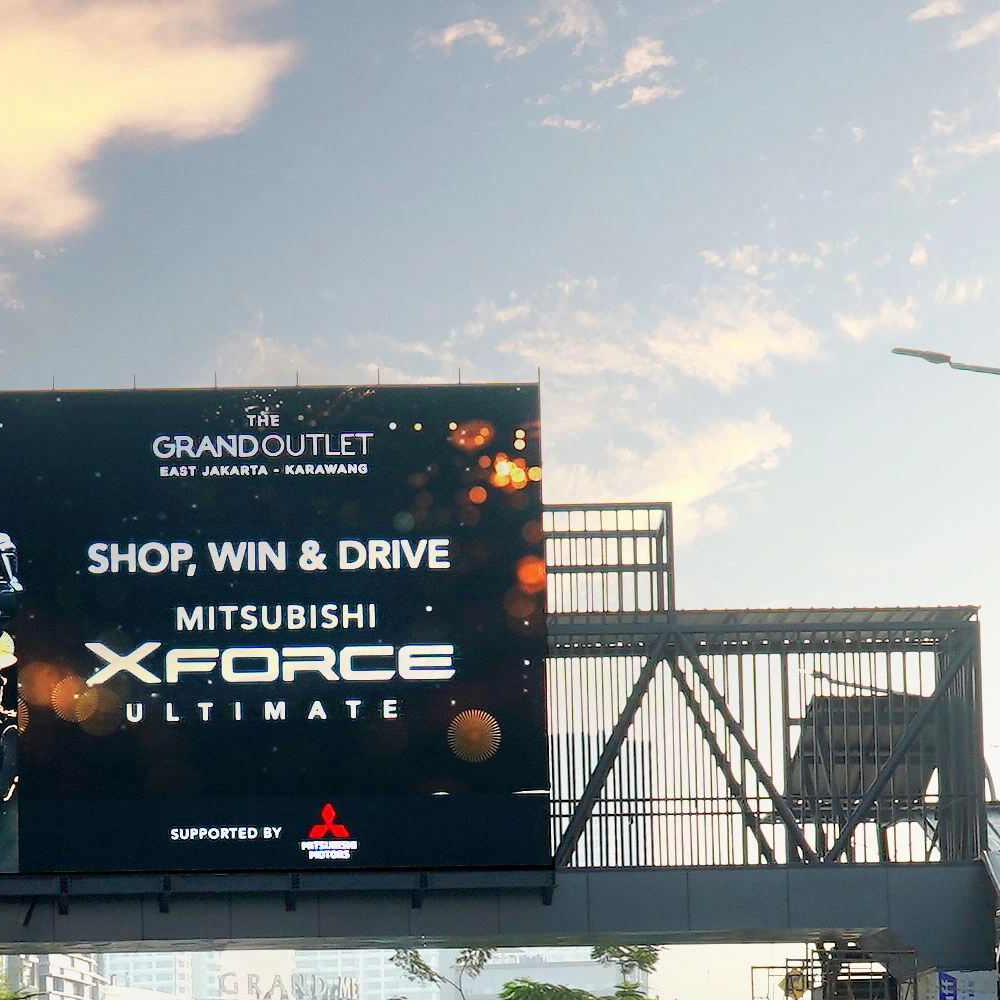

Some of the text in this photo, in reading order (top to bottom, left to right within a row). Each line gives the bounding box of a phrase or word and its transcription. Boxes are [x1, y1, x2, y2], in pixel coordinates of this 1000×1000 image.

[247, 414, 280, 427] THE
[159, 465, 197, 477] EAST
[202, 464, 268, 476] JAKARTA
[284, 463, 368, 475] KARAWANG
[87, 538, 451, 577] SHOP, WIN & DRIVE
[176, 603, 377, 631] MITSUBISHI
[84, 641, 456, 686] XFORCE
[126, 699, 399, 722] ULTIMATE
[170, 826, 282, 841] SUPPORTED BY
[219, 972, 326, 998] GRAND
